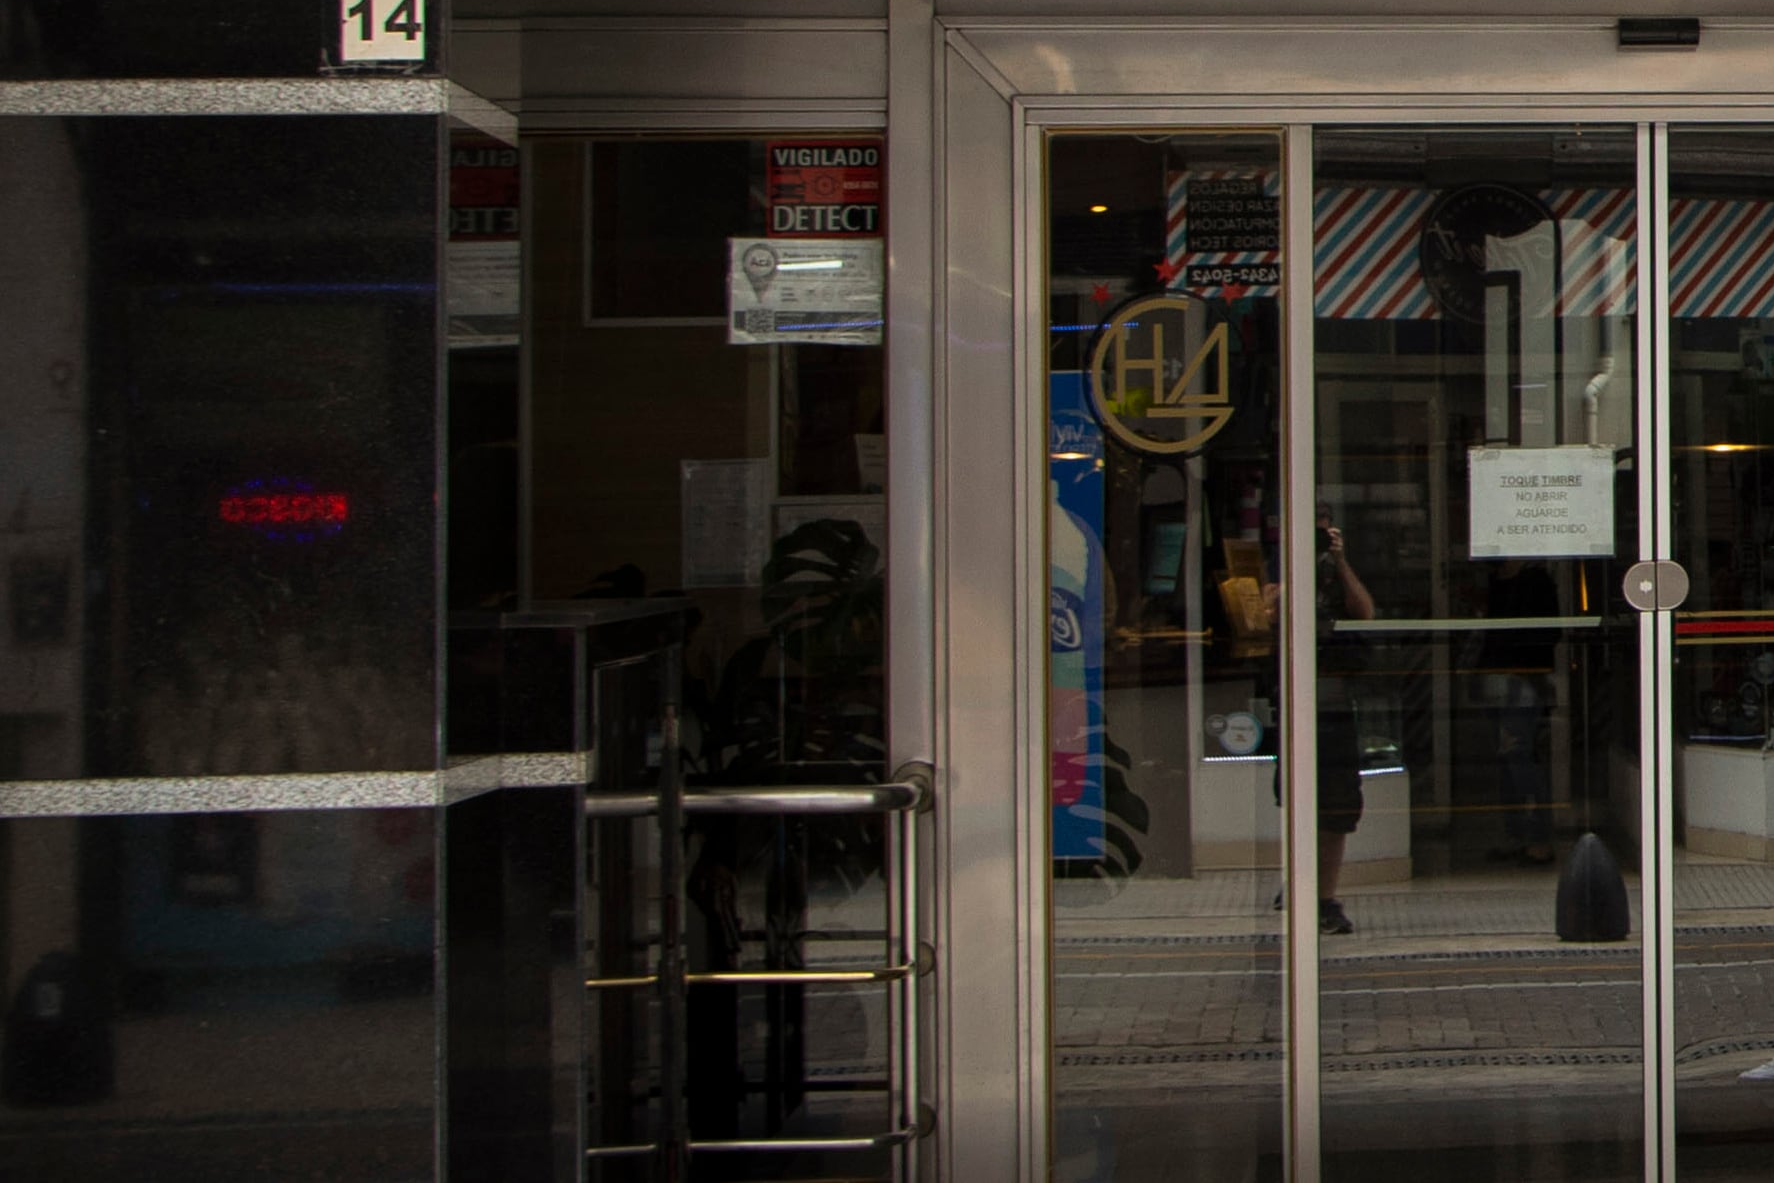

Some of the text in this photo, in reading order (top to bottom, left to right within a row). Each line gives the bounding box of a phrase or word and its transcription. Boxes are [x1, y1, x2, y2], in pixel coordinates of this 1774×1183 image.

[773, 148, 879, 167] VIGILADO
[773, 204, 879, 232] DETECT
[1500, 474, 1582, 486] TOQUE TIMBRE
[1515, 491, 1568, 502] NO ABRIR
[1516, 507, 1569, 519] AGUARDE
[1497, 523, 1587, 535] A SER ATENDIDO
